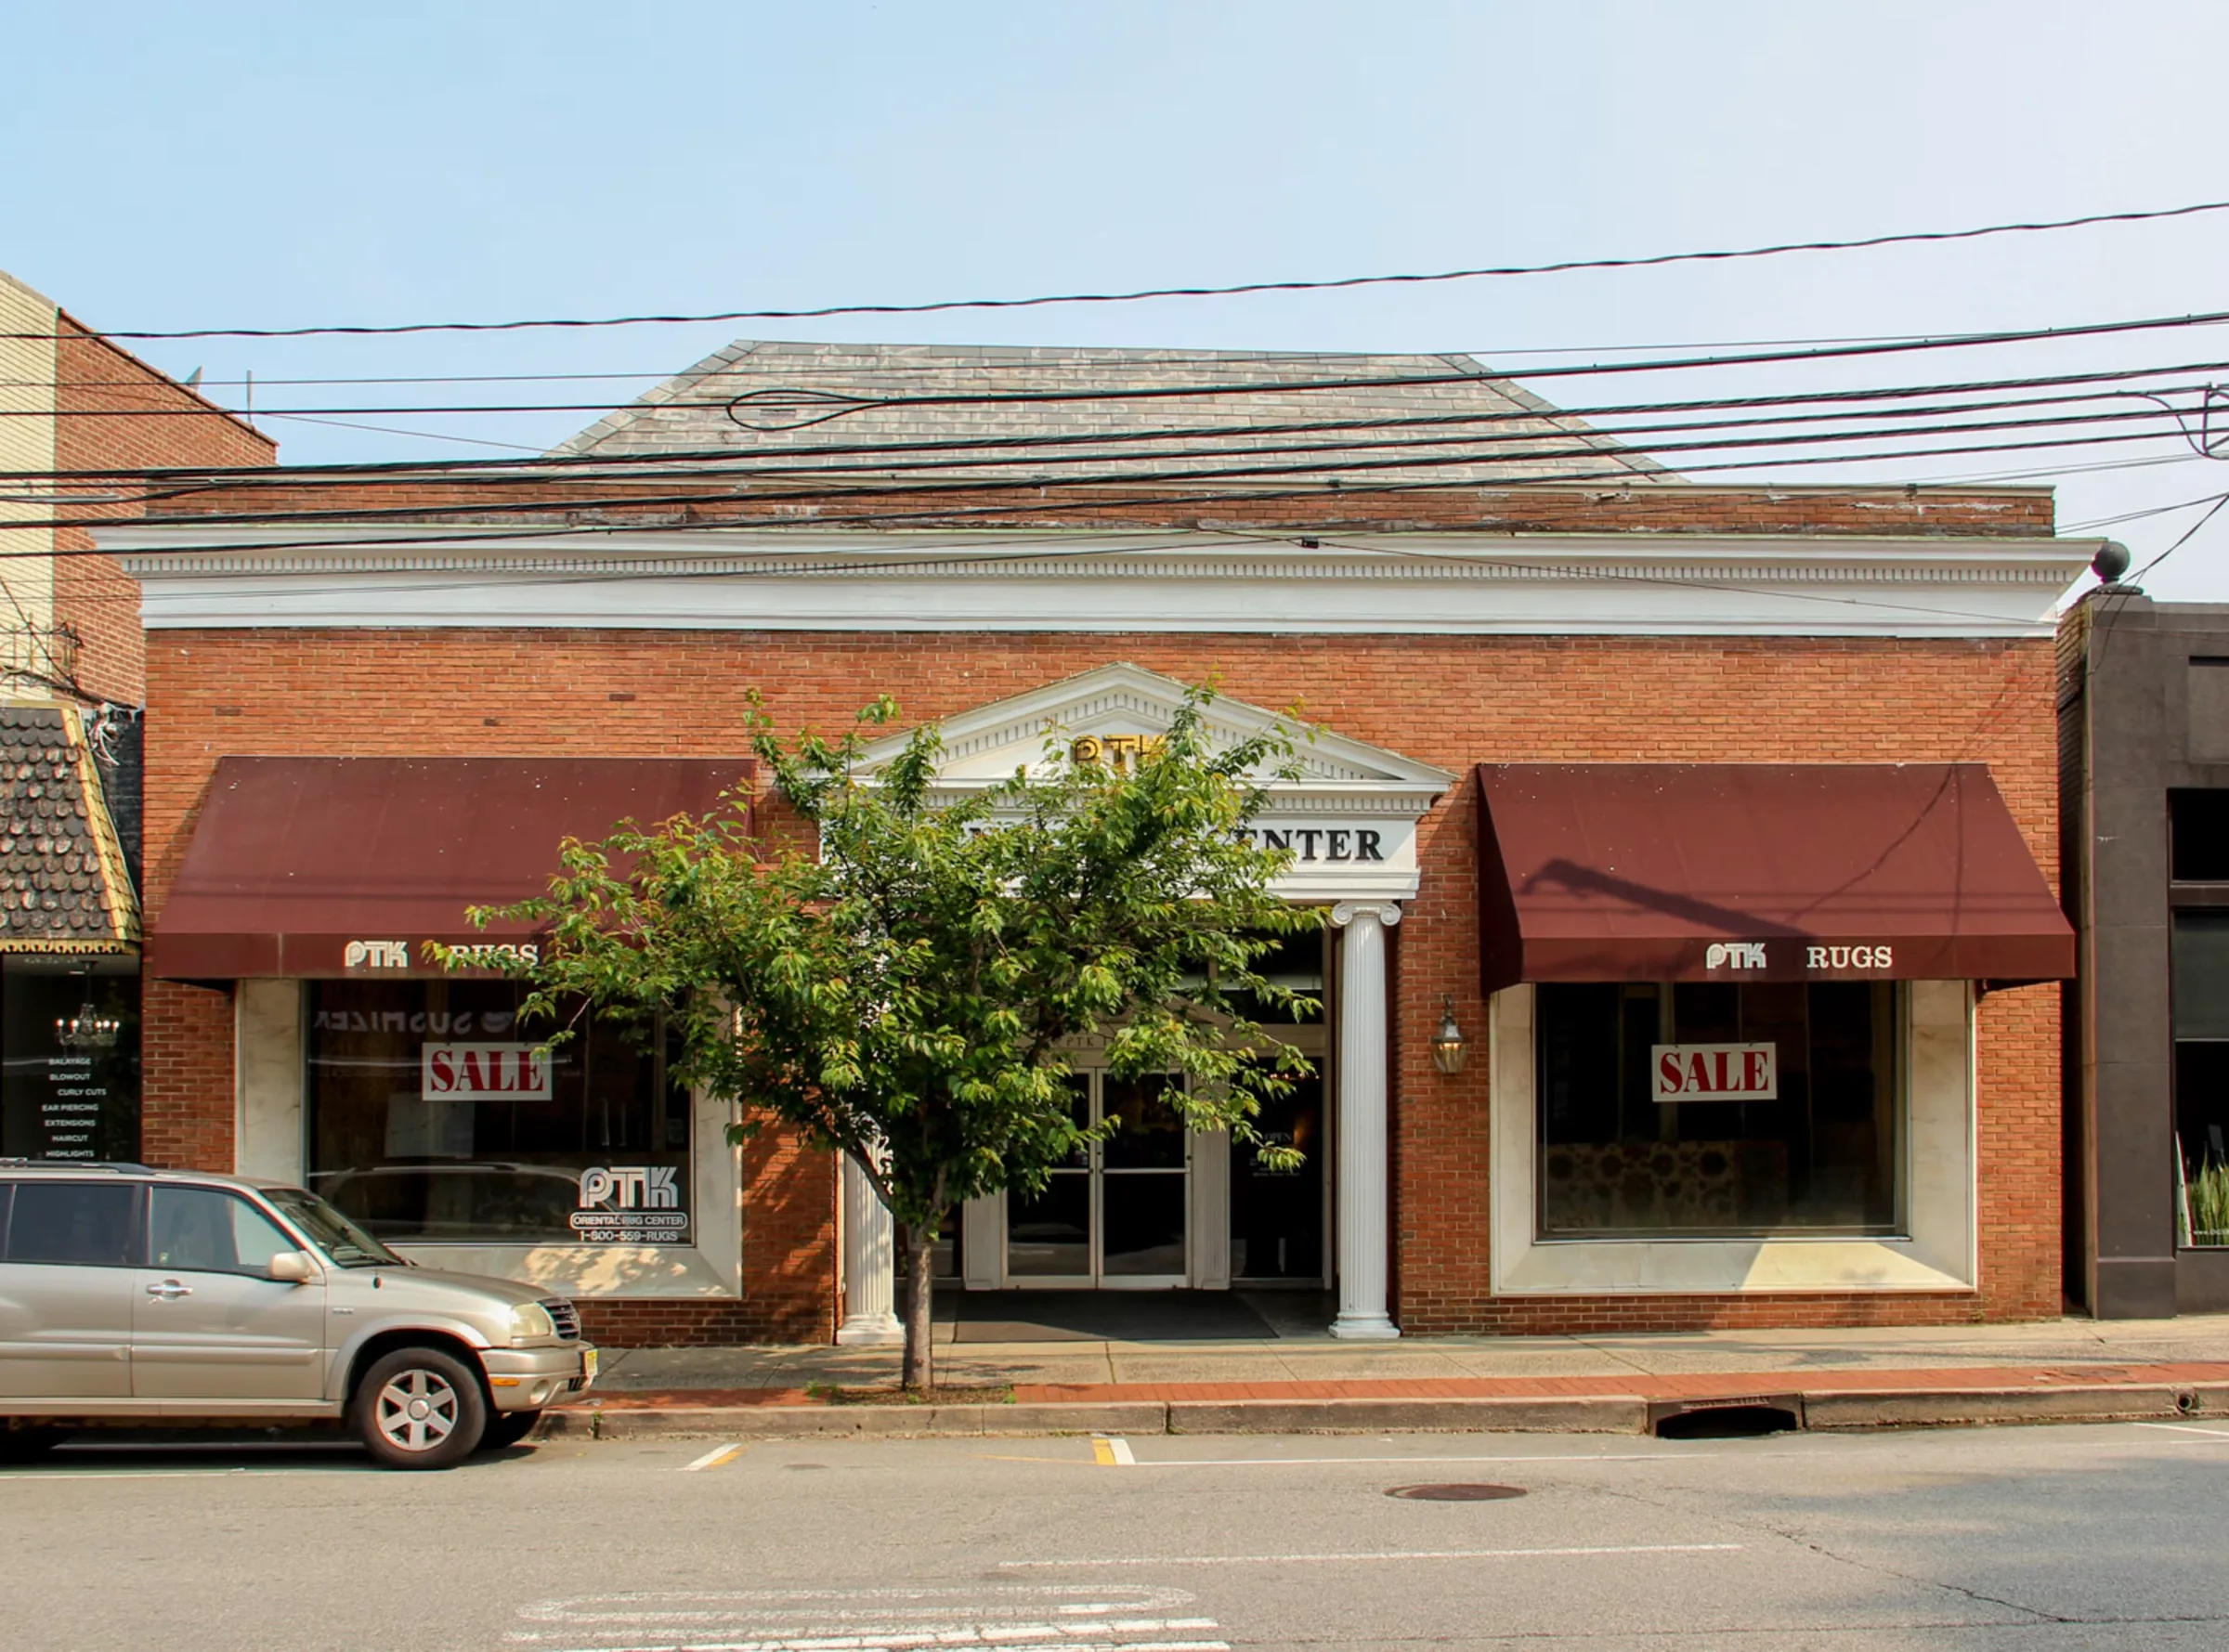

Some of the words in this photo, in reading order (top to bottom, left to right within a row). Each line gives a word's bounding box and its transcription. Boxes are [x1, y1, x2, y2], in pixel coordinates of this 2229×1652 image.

[1209, 829, 1384, 861] NTER
[345, 940, 408, 968] PTK
[1706, 943, 1766, 969] PTK
[1806, 946, 1893, 969] RUGS
[48, 1057, 92, 1066] BALAYAGE
[430, 1049, 544, 1093] SALE
[1659, 1050, 1769, 1094] SALE
[57, 1087, 84, 1096] CURLY
[85, 1087, 108, 1096] CUTS
[41, 1103, 59, 1112] EAR
[60, 1103, 99, 1112] PIERCING
[44, 1119, 97, 1127] EXTENSIONS
[51, 1134, 89, 1142] HAIRCUT
[46, 1150, 95, 1158] HIGHLIGHTS
[580, 1166, 679, 1208] PTK
[572, 1216, 620, 1226] ORIENTAL
[621, 1216, 644, 1226] RUG
[644, 1216, 684, 1226] CENTER
[580, 1229, 679, 1242] 1-800-559-RUGS
